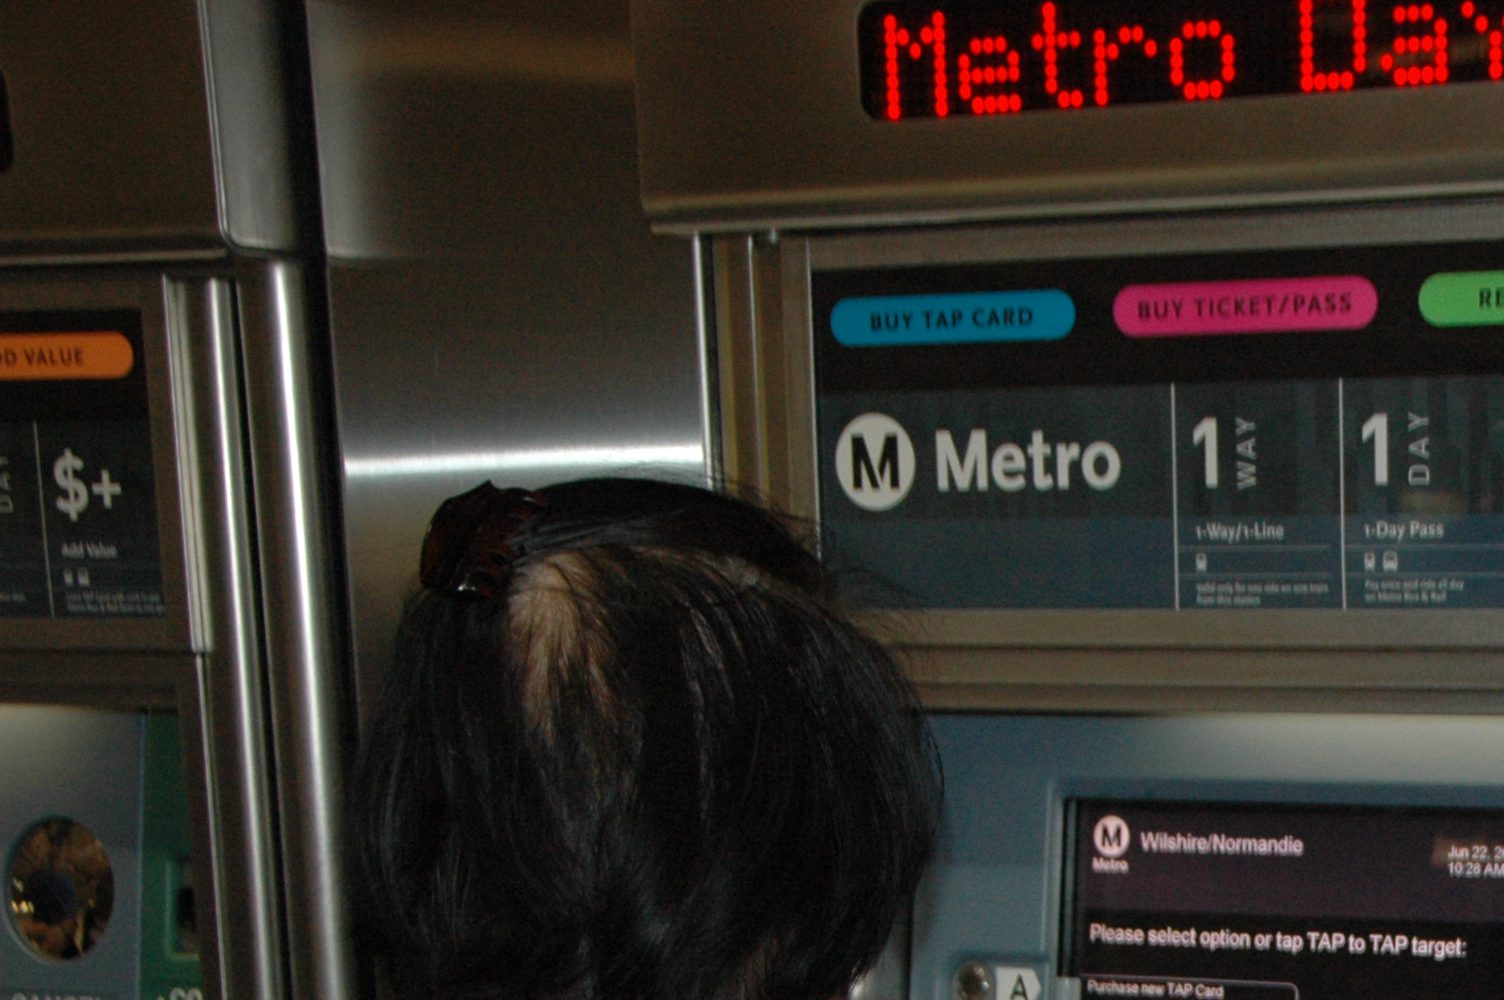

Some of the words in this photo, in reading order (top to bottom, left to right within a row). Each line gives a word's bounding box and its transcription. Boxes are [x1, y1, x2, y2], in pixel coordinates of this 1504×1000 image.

[884, 2, 1239, 120] Metro
[871, 313, 912, 332] BUY
[924, 312, 964, 331] TAP
[972, 308, 1034, 329] CARD
[1138, 299, 1184, 320] BUY
[1194, 292, 1351, 318] TICKET/PASS
[24, 347, 84, 367] VALUE
[935, 429, 1122, 492] Metro
[1192, 416, 1227, 489] 1
[1235, 416, 1257, 490] WAY
[1361, 411, 1390, 486] 1
[1407, 411, 1431, 486] DAY
[1364, 520, 1405, 543] 1-Day
[1410, 520, 1445, 539] Pass
[1140, 831, 1304, 857] Wilshire/Normandie
[1092, 856, 1129, 873] Metro
[1090, 922, 1145, 945] Please
[1148, 926, 1196, 947] select
[1200, 928, 1250, 952] option
[1254, 933, 1271, 948] or
[1275, 931, 1303, 954] tap
[1307, 931, 1346, 953] TAP
[1349, 933, 1366, 954] to
[1370, 934, 1408, 955] TAP
[1411, 935, 1468, 961] target:
[1087, 979, 1139, 997] Purchase
[1141, 983, 1165, 997] new
[1167, 982, 1194, 998] TAP
[1194, 983, 1225, 1000] Card
